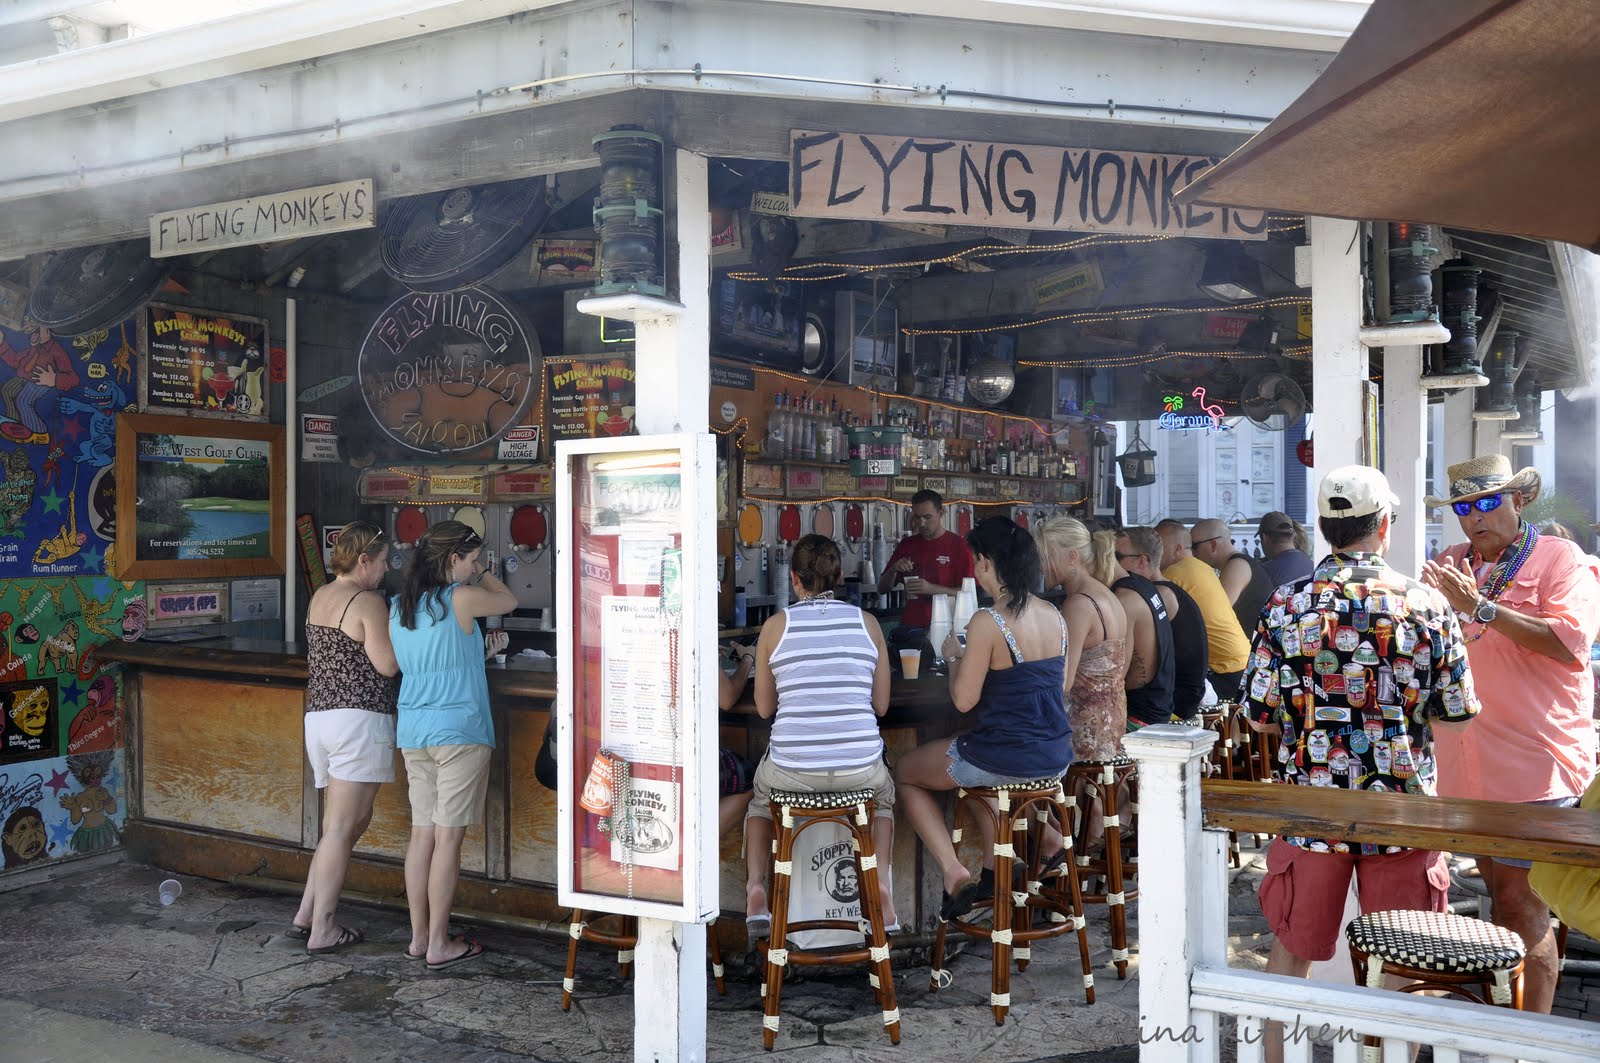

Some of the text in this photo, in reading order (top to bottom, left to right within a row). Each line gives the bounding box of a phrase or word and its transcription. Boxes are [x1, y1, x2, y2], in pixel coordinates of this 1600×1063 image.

[792, 132, 1036, 223] FLYING
[159, 189, 367, 250] FLYING MONKEYS
[377, 293, 514, 356] FLYING
[154, 318, 246, 346] FLYING MONKEYS
[180, 330, 209, 344] SALOON
[152, 342, 177, 351] Souvenir
[179, 345, 189, 353] Cup
[152, 355, 174, 364] Squeeze
[176, 356, 193, 365] Bottle
[152, 372, 168, 380] Yards
[553, 364, 635, 390] FLYING MONKEY
[575, 379, 604, 391] SALOON
[152, 389, 173, 398] Jumbos
[552, 394, 574, 402] Souvenir
[574, 394, 584, 402] Cup
[552, 406, 572, 414] Squeeze
[308, 420, 333, 431] DANGE
[1159, 412, 1212, 430] Corona
[507, 430, 533, 439] DANGER
[142, 440, 263, 459] KEY WEST GOLF CLUB
[509, 442, 528, 450] HIGH
[503, 450, 533, 458] VOLTAGE
[8, 493, 29, 503] Thong
[150, 539, 161, 547] For
[162, 540, 203, 548] reservations
[228, 539, 245, 547] times
[32, 563, 77, 573] Rum Runner
[23, 590, 52, 624] Margarita
[159, 595, 217, 613] GRAPE APE
[7, 653, 32, 672] Colada
[68, 739, 85, 752] Third
[84, 726, 105, 742] Degree
[629, 789, 661, 801] FLYING
[811, 842, 855, 871] SLOPPY
[825, 906, 861, 919] KEY WE
